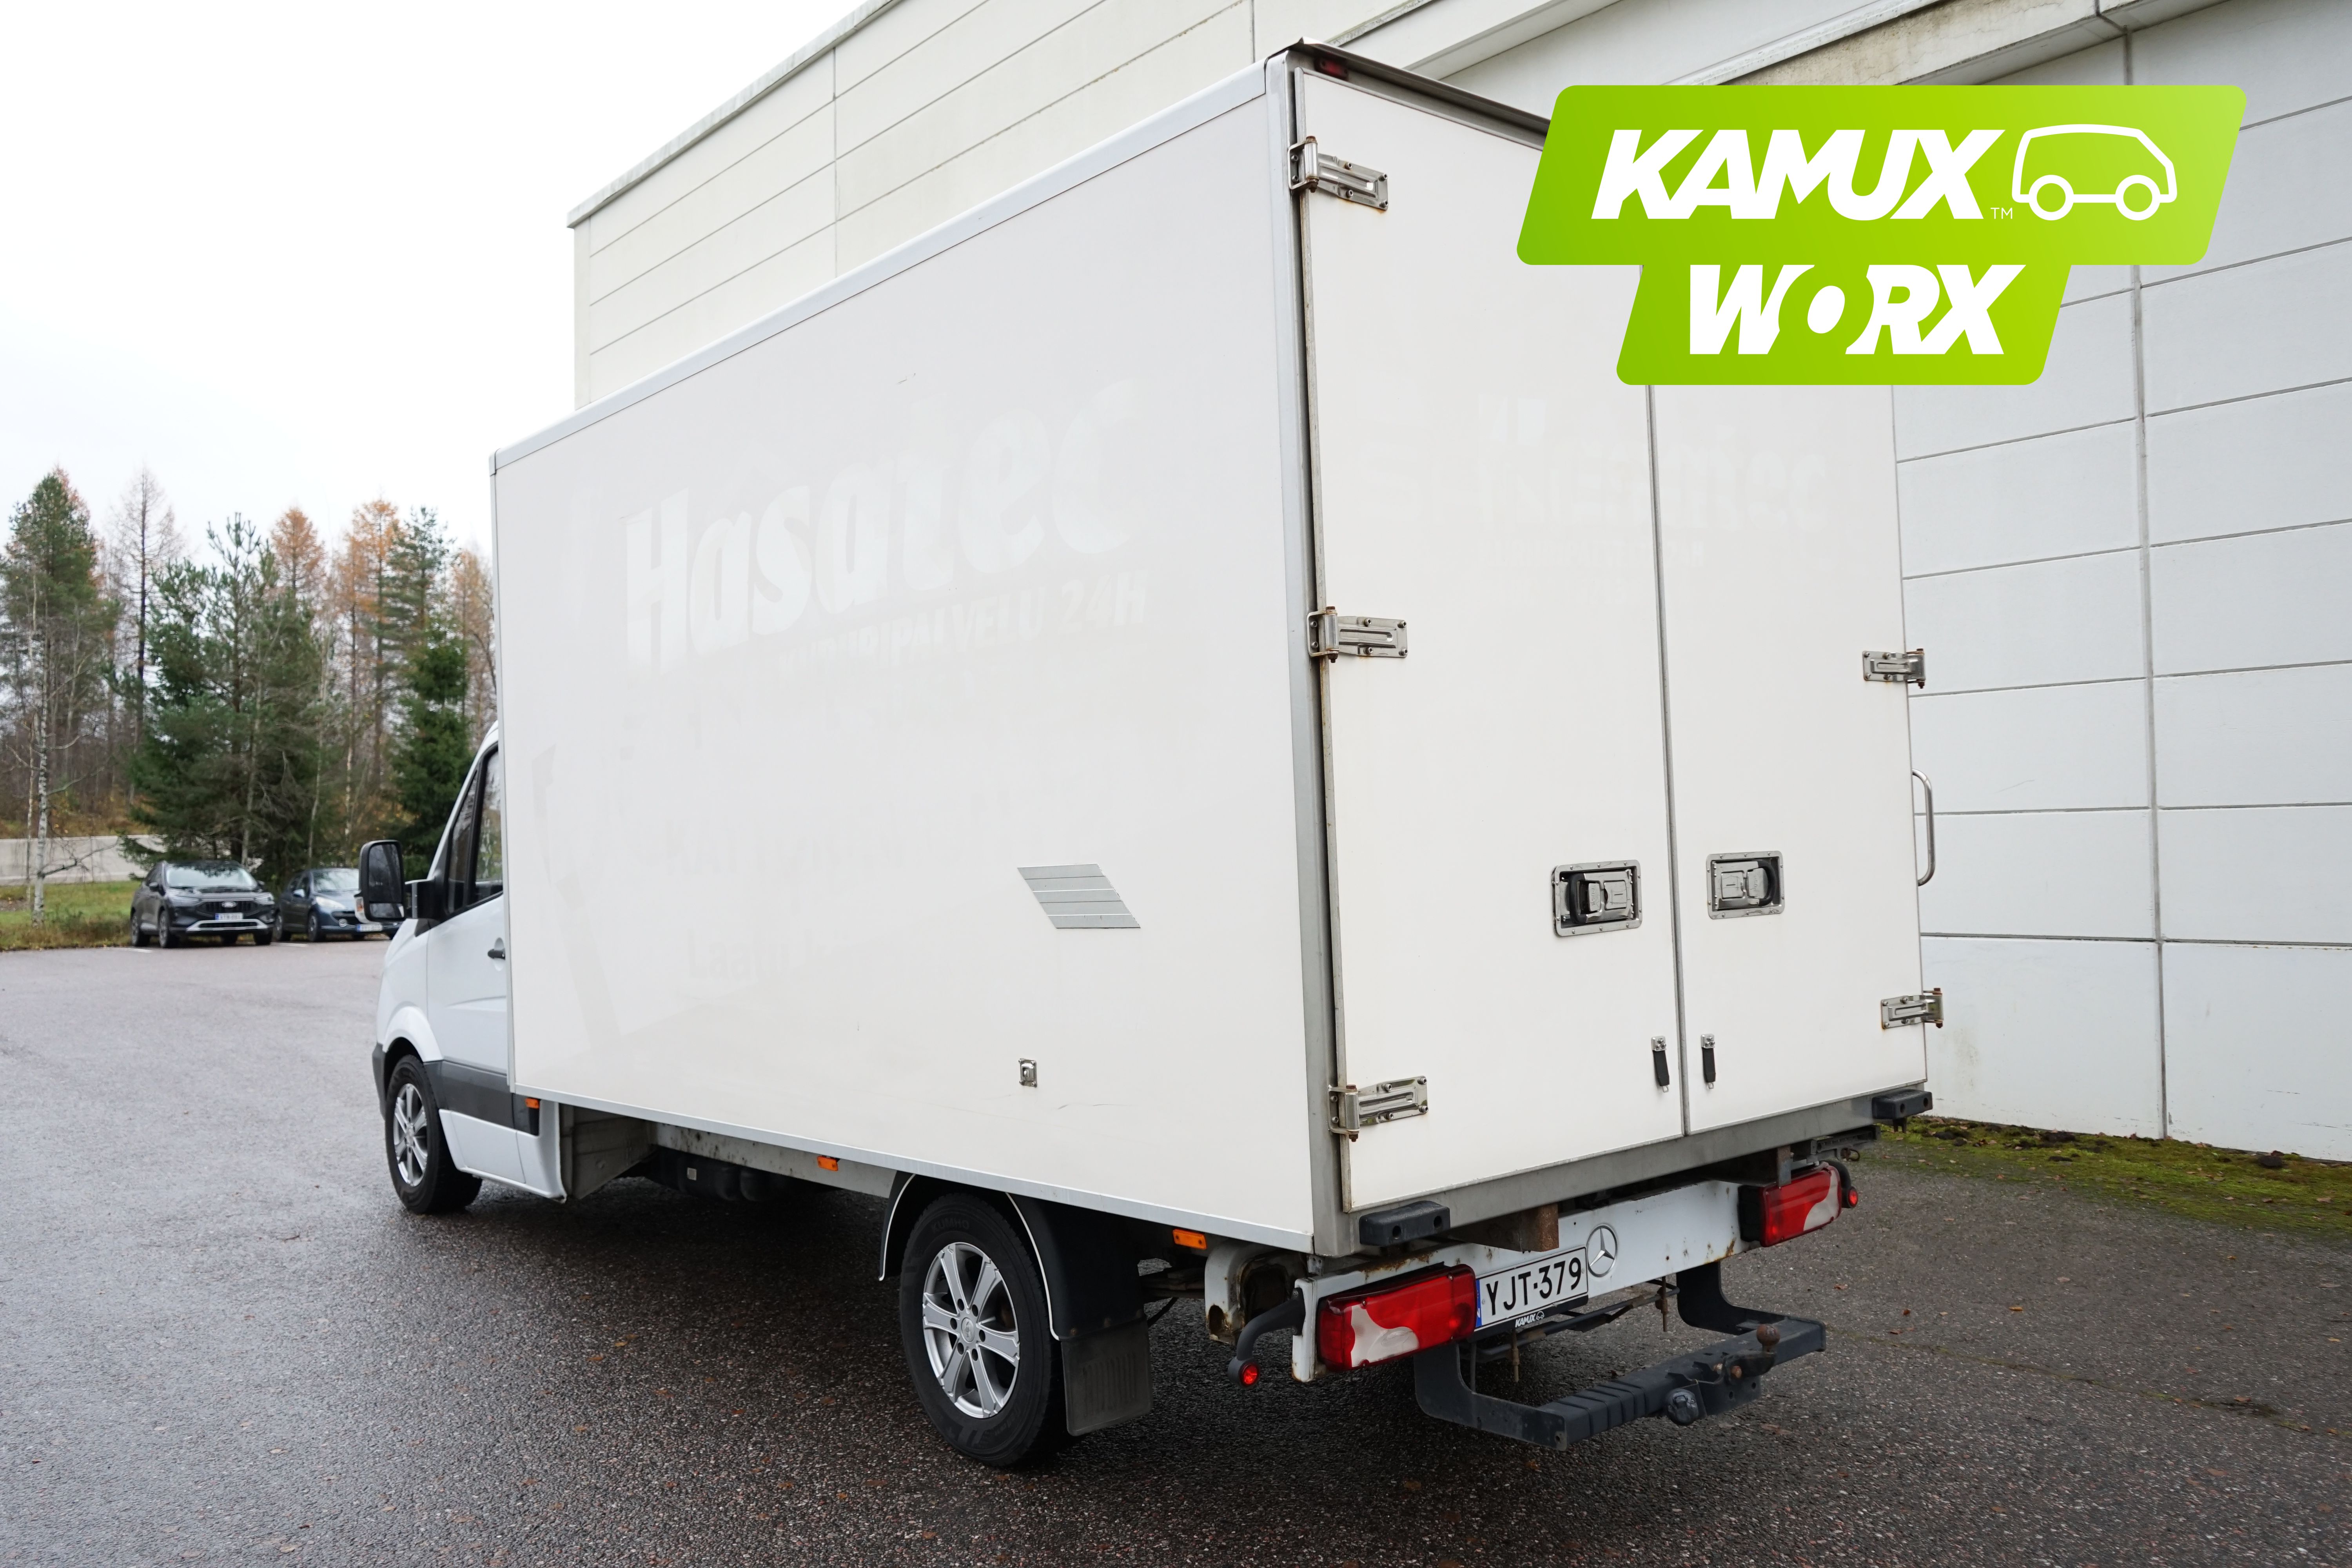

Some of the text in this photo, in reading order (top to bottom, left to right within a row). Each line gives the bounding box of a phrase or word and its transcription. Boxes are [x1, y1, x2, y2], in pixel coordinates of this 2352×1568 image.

[931, 1217, 970, 1234] KUMHO
[1486, 1257, 1582, 1316] YJT-379
[1515, 1313, 1536, 1328] KAMUX
